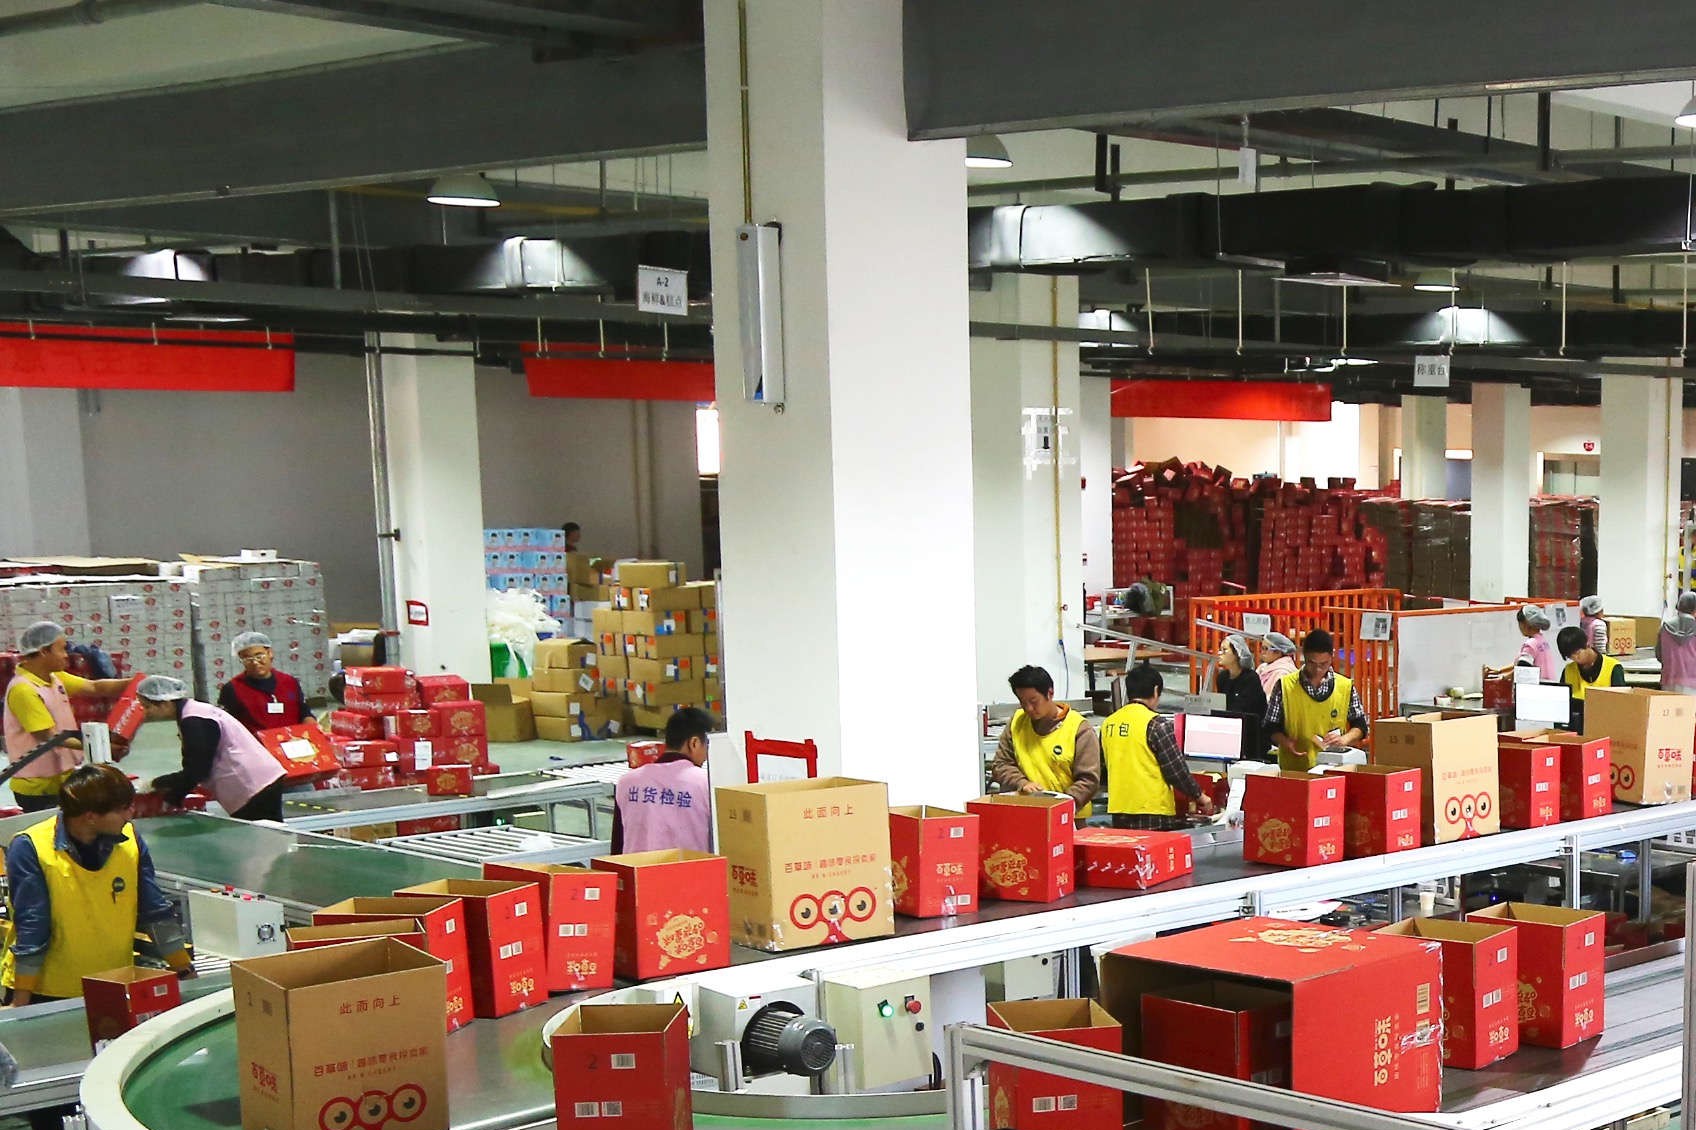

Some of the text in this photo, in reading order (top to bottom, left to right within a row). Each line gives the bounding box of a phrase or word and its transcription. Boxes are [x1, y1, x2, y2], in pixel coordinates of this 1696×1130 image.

[628, 786, 693, 808] 出货检验
[803, 804, 855, 820] 此面向上
[339, 994, 401, 1015] 此面向上
